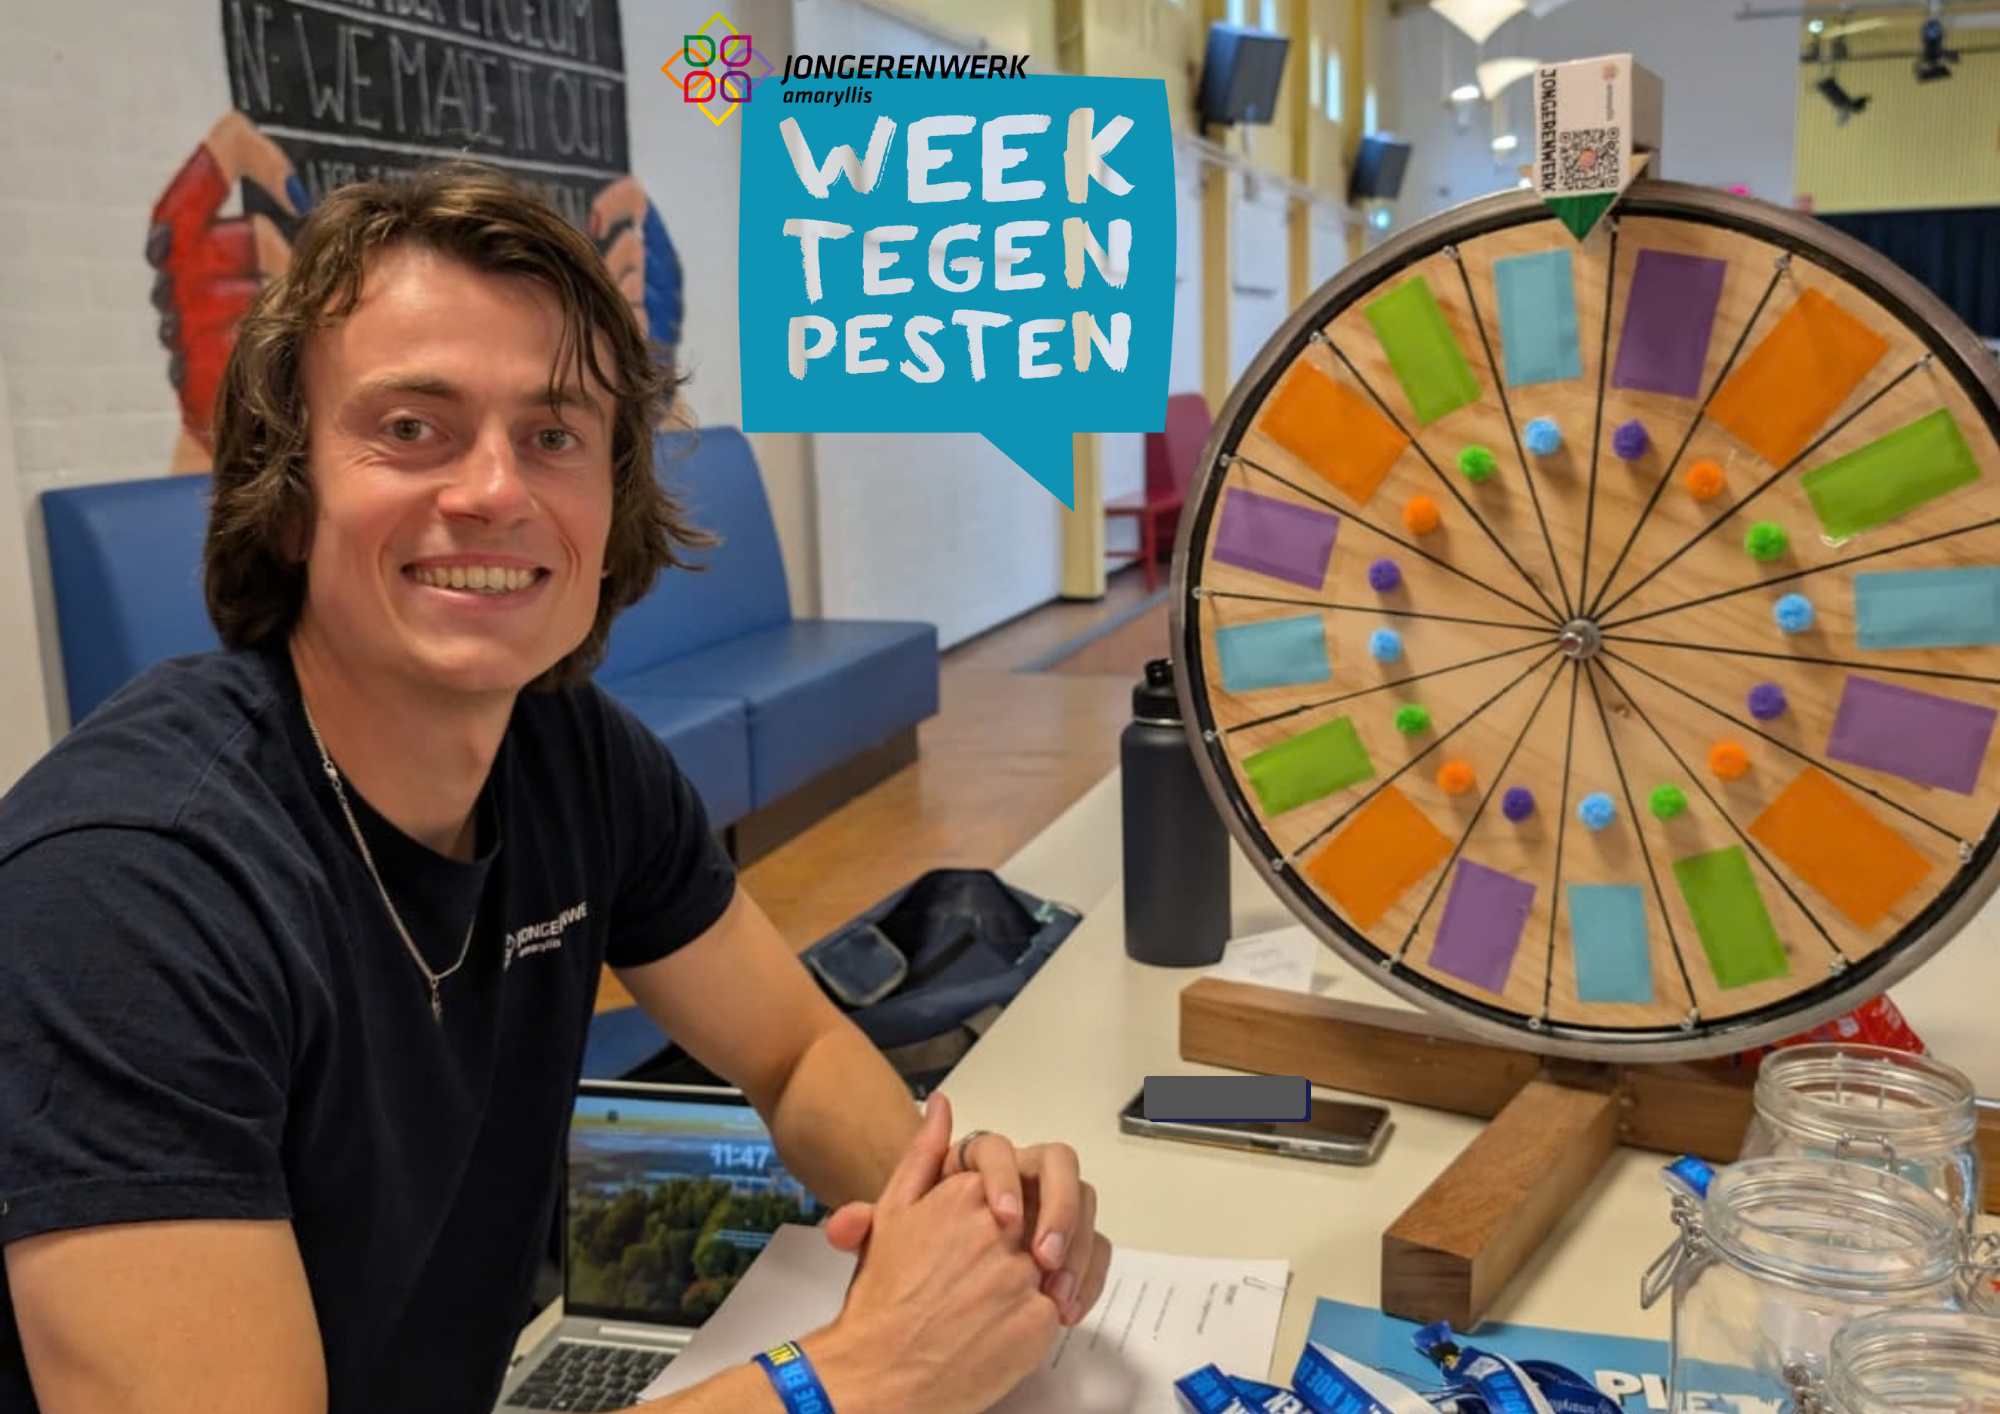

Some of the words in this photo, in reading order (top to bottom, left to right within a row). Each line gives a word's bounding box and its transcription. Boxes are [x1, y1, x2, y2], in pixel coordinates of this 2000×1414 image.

[294, 14, 382, 130] WE
[390, 37, 503, 146] MADE
[546, 72, 614, 162] OUT
[1541, 69, 1557, 191] JONGERENWERK
[710, 1143, 770, 1169] 11:47
